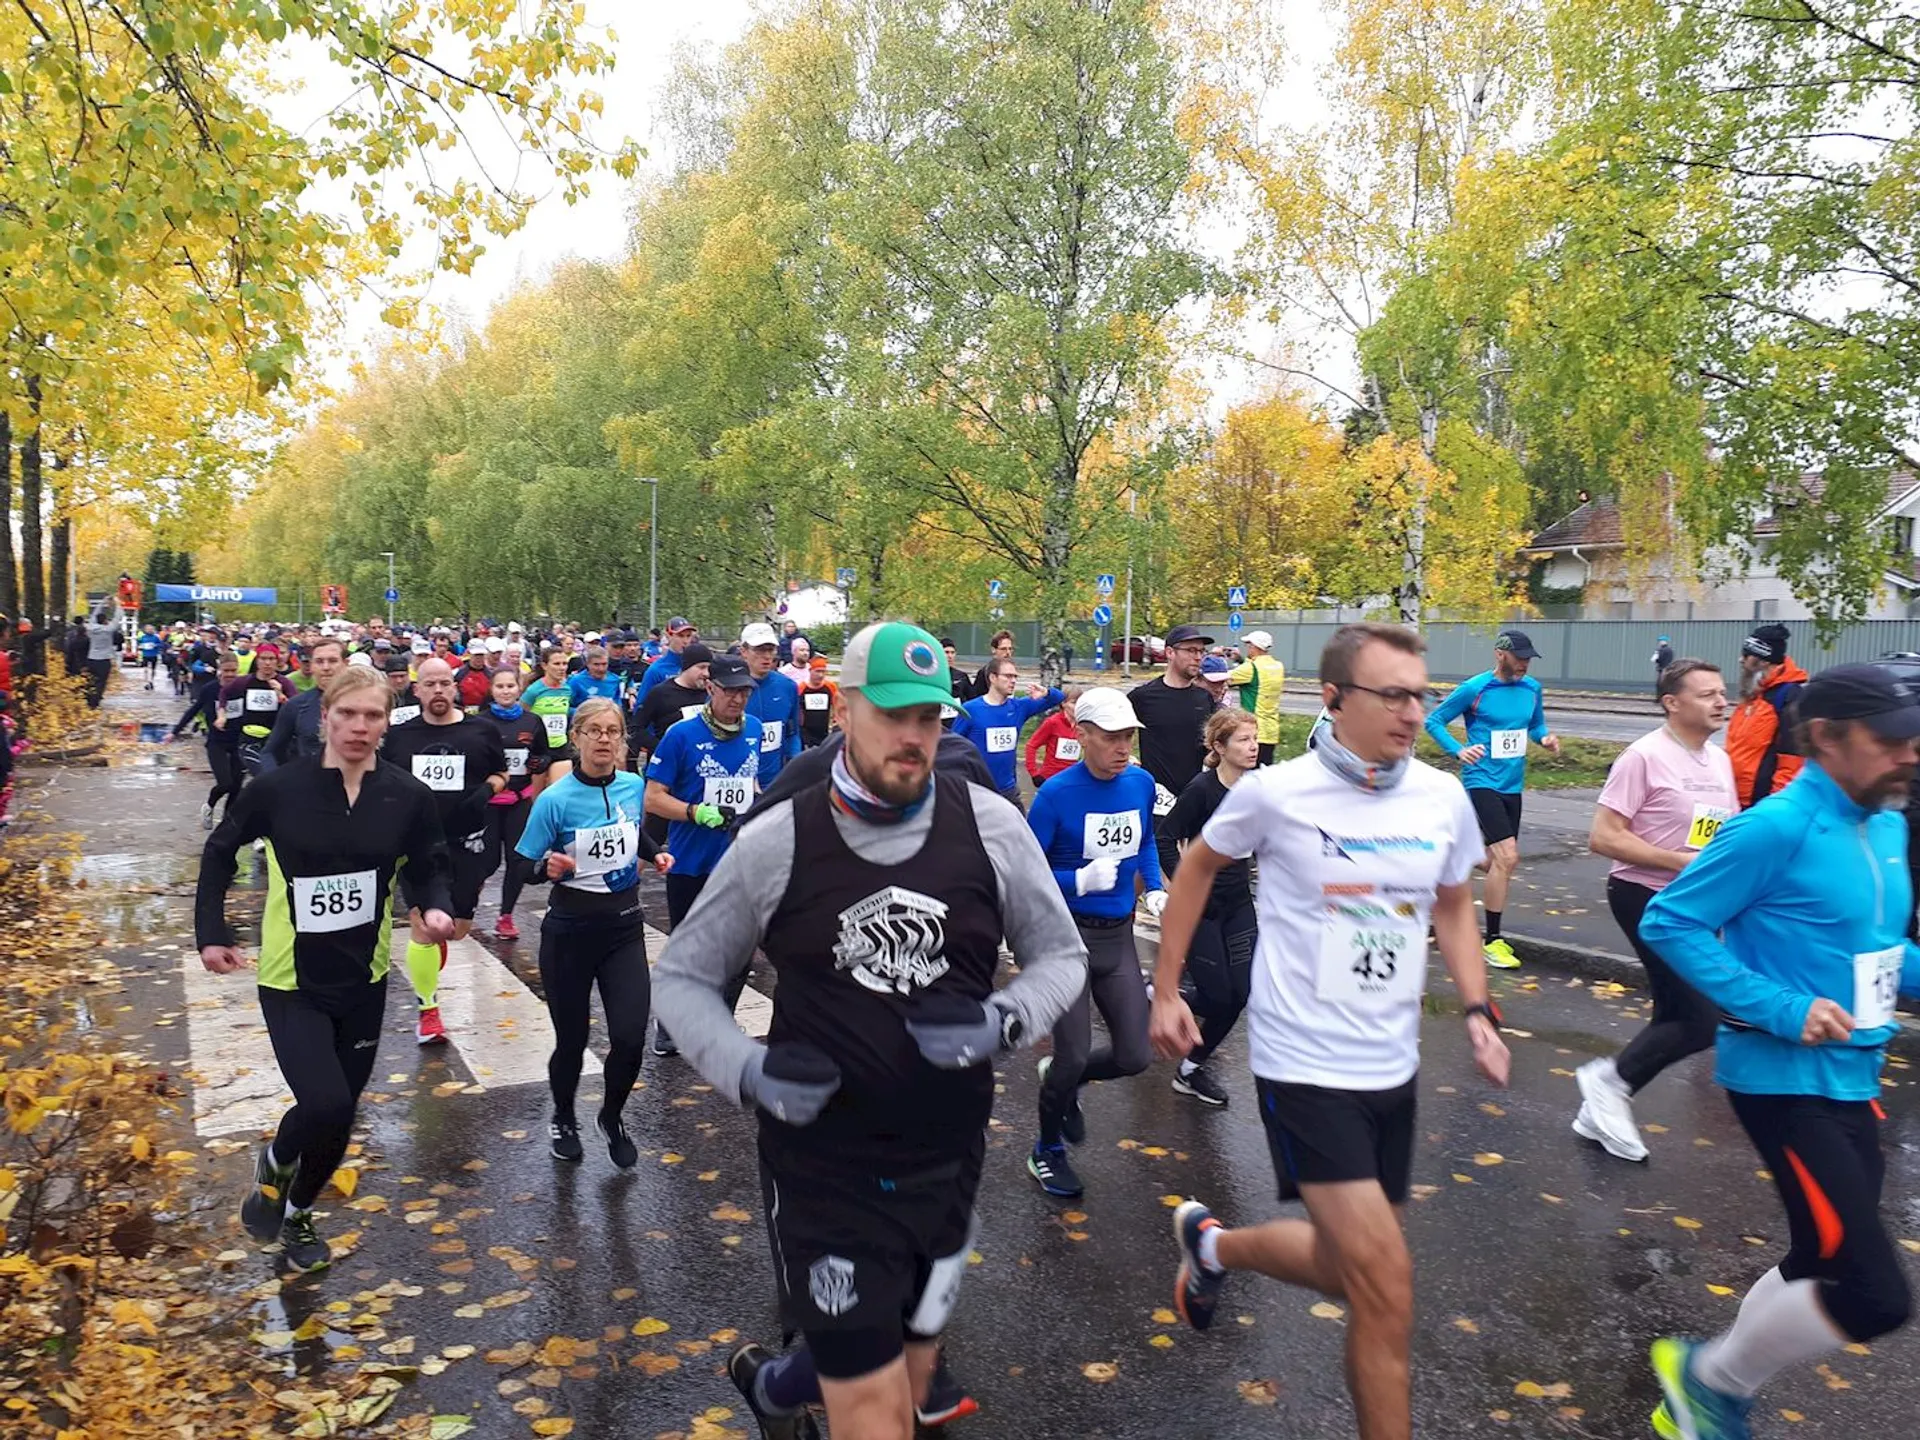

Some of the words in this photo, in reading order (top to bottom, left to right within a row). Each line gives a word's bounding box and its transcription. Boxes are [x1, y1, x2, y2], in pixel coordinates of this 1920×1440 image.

[547, 720, 564, 730] 475
[994, 734, 1012, 745] 155
[1502, 738, 1517, 750] 61
[421, 765, 455, 780] 490
[714, 789, 745, 804] 180
[592, 827, 624, 841] Aktia
[1097, 826, 1133, 847] 349
[588, 837, 626, 859] 451
[313, 877, 359, 893] Aktia
[309, 889, 363, 917] 585
[1351, 949, 1397, 981] 43
